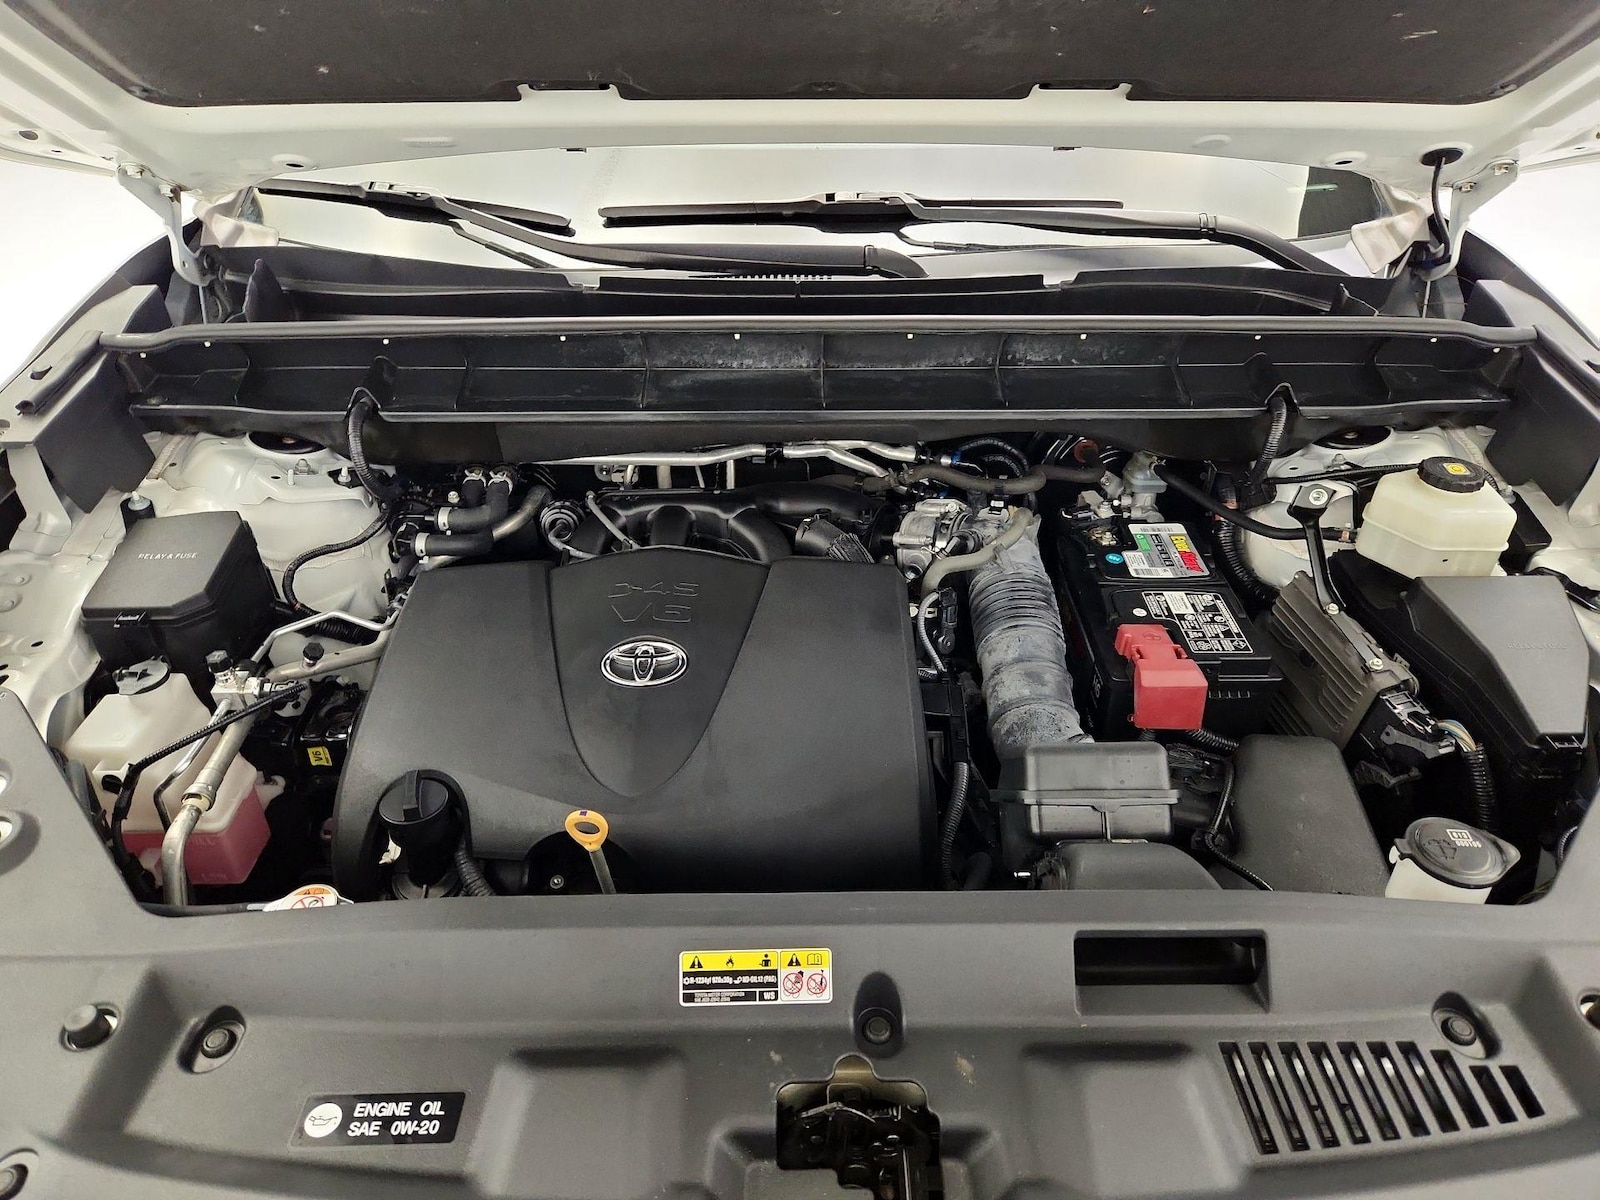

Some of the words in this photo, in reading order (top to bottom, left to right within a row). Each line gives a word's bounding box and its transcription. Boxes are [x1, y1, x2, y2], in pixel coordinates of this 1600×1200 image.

[611, 601, 692, 623] V6
[763, 991, 776, 1000] WS
[353, 1101, 413, 1118] ENGINE
[419, 1100, 445, 1116] OIL
[347, 1120, 382, 1137] SAE
[390, 1119, 440, 1136] 0W-20
